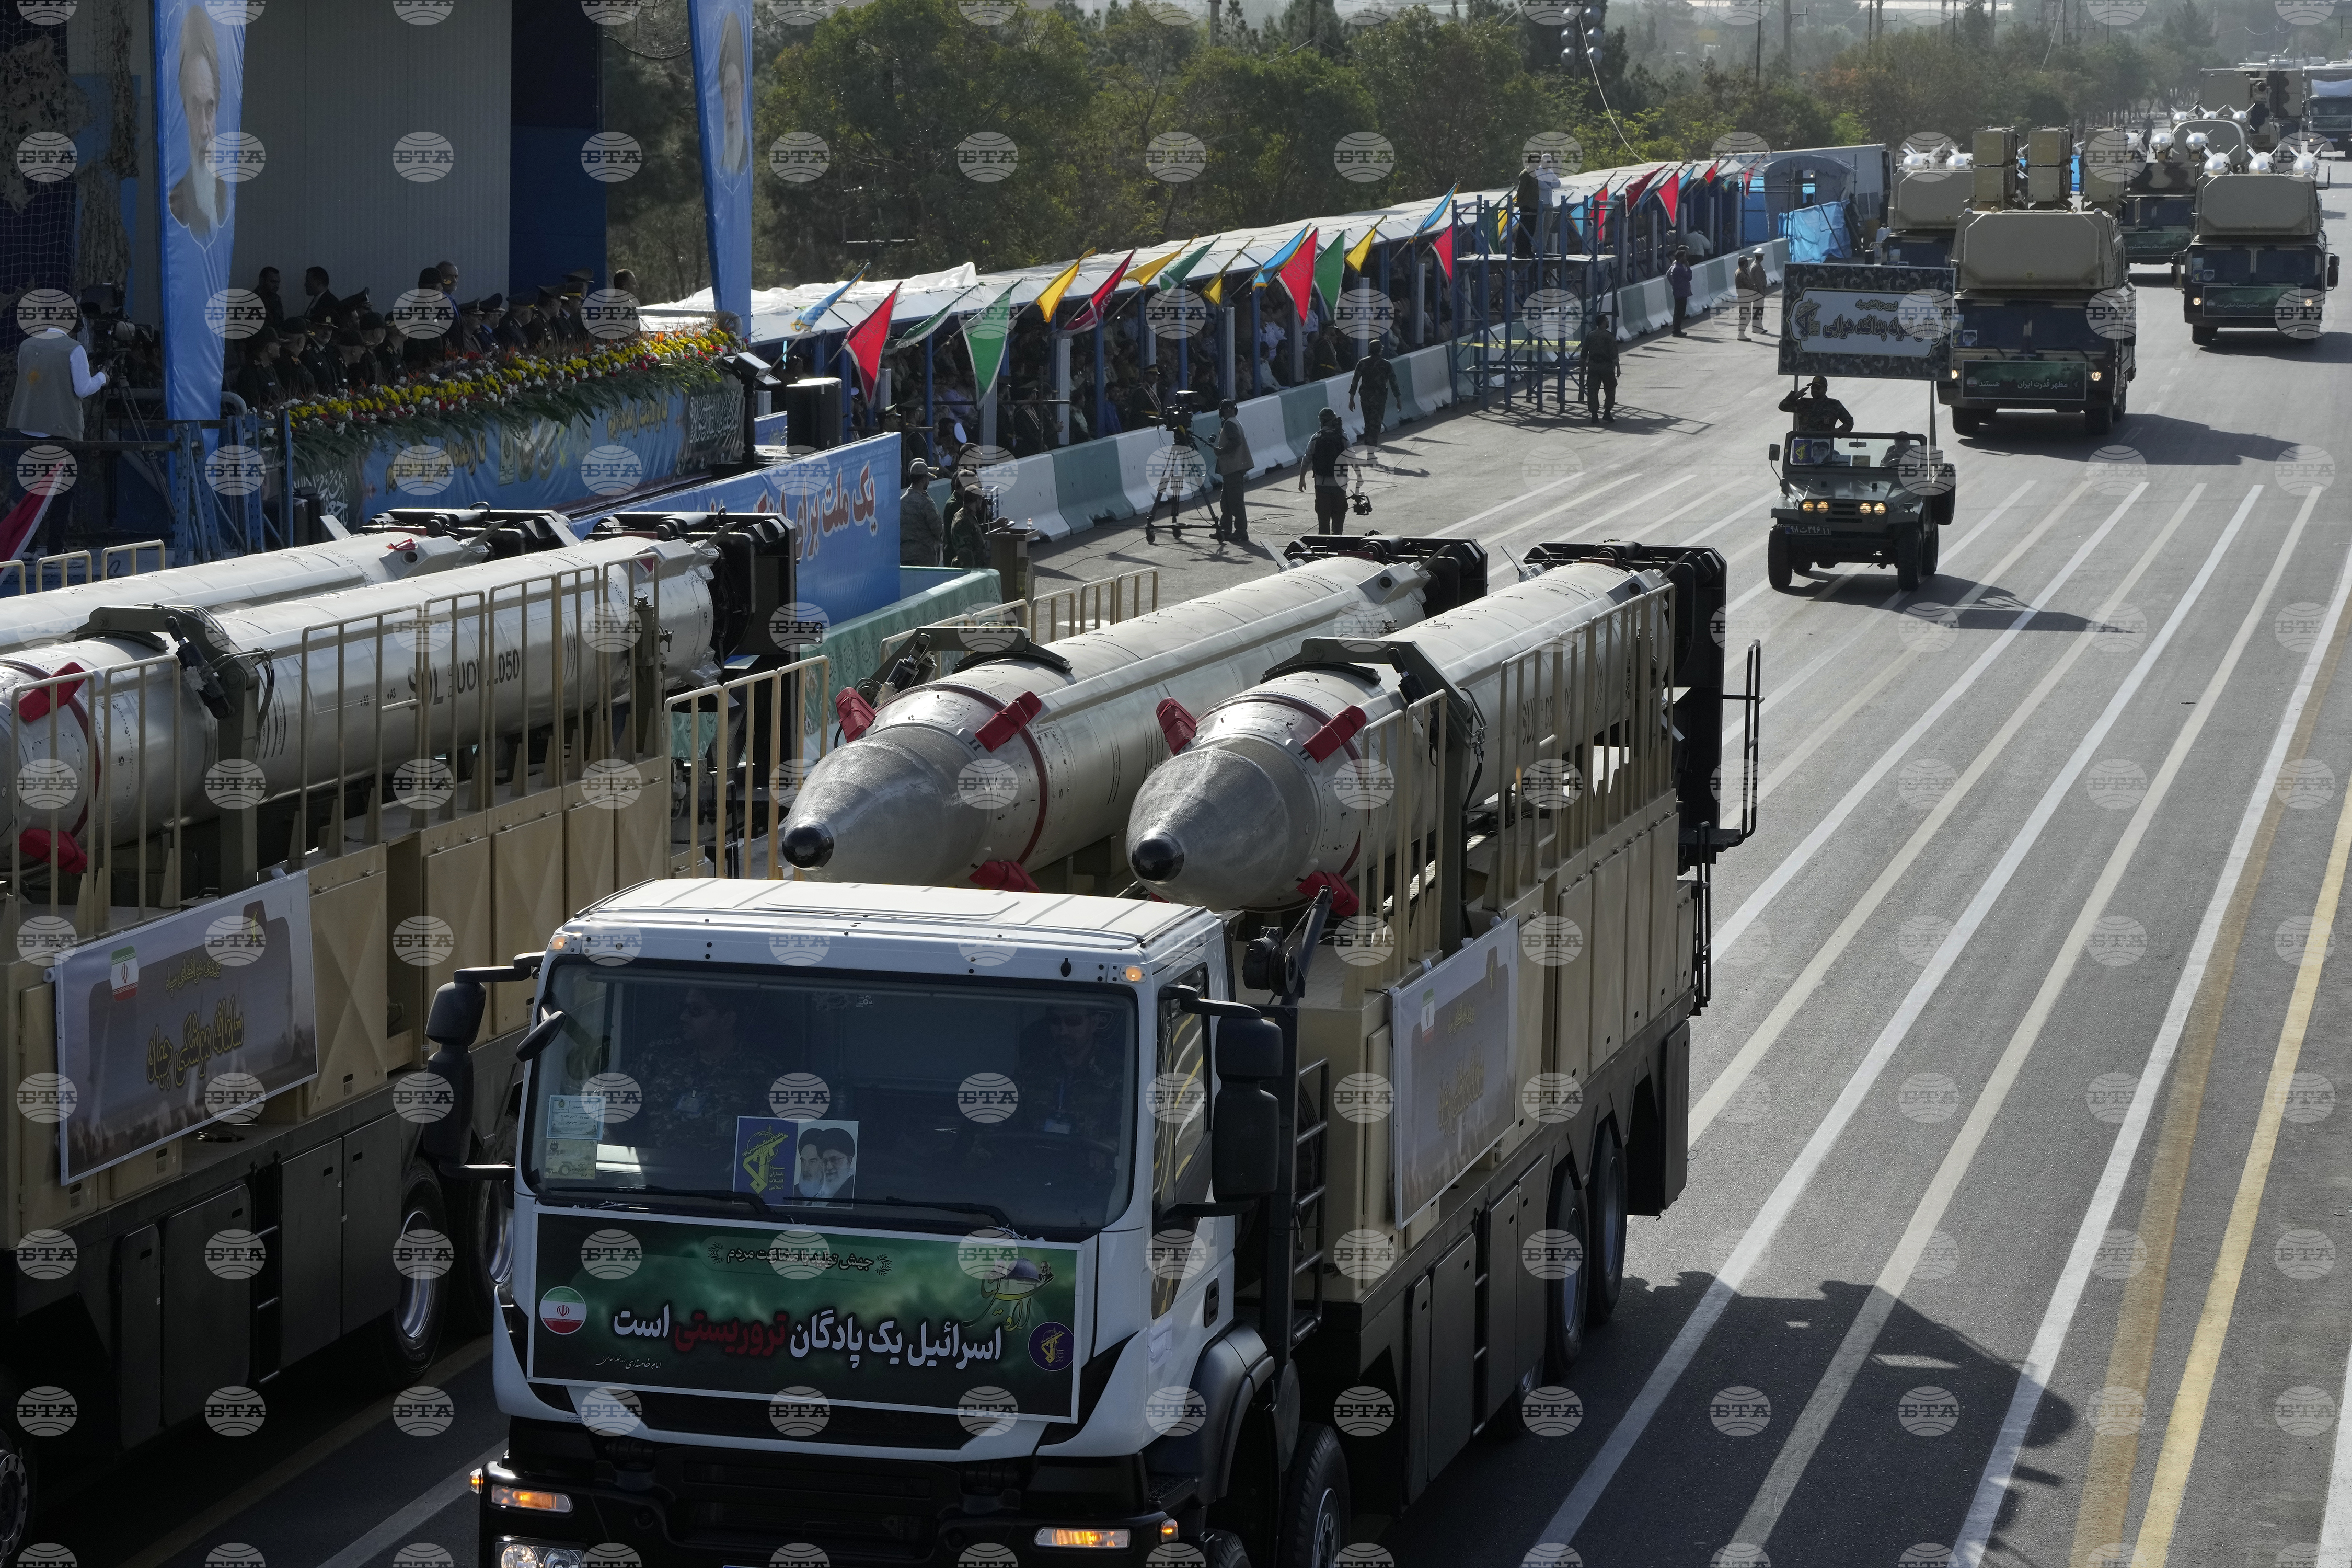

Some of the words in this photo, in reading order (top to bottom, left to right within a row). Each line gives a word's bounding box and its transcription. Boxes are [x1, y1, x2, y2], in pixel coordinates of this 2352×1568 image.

[1823, 314, 1854, 339] هوایی
[1855, 314, 1888, 342] پدافند
[1887, 317, 1913, 341] نمونه
[2017, 381, 2033, 389] ایران
[2033, 379, 2050, 389] قدرت
[2051, 381, 2068, 389] مظهر
[821, 466, 850, 537] ملت
[852, 460, 878, 537] یک
[166, 966, 177, 998] سپاه
[174, 1012, 212, 1086] موشکی
[727, 1249, 754, 1263] مردم
[757, 1248, 799, 1264] مشارکت
[800, 1249, 810, 1266] با
[810, 1250, 837, 1269] تولید
[839, 1255, 874, 1271] جهش
[614, 1303, 670, 1338] است
[674, 1312, 787, 1356] تروریستی
[790, 1309, 863, 1368] پادگان
[868, 1320, 902, 1364] یک
[907, 1321, 1001, 1369] اسرائیل
[651, 1361, 661, 1370] امام
